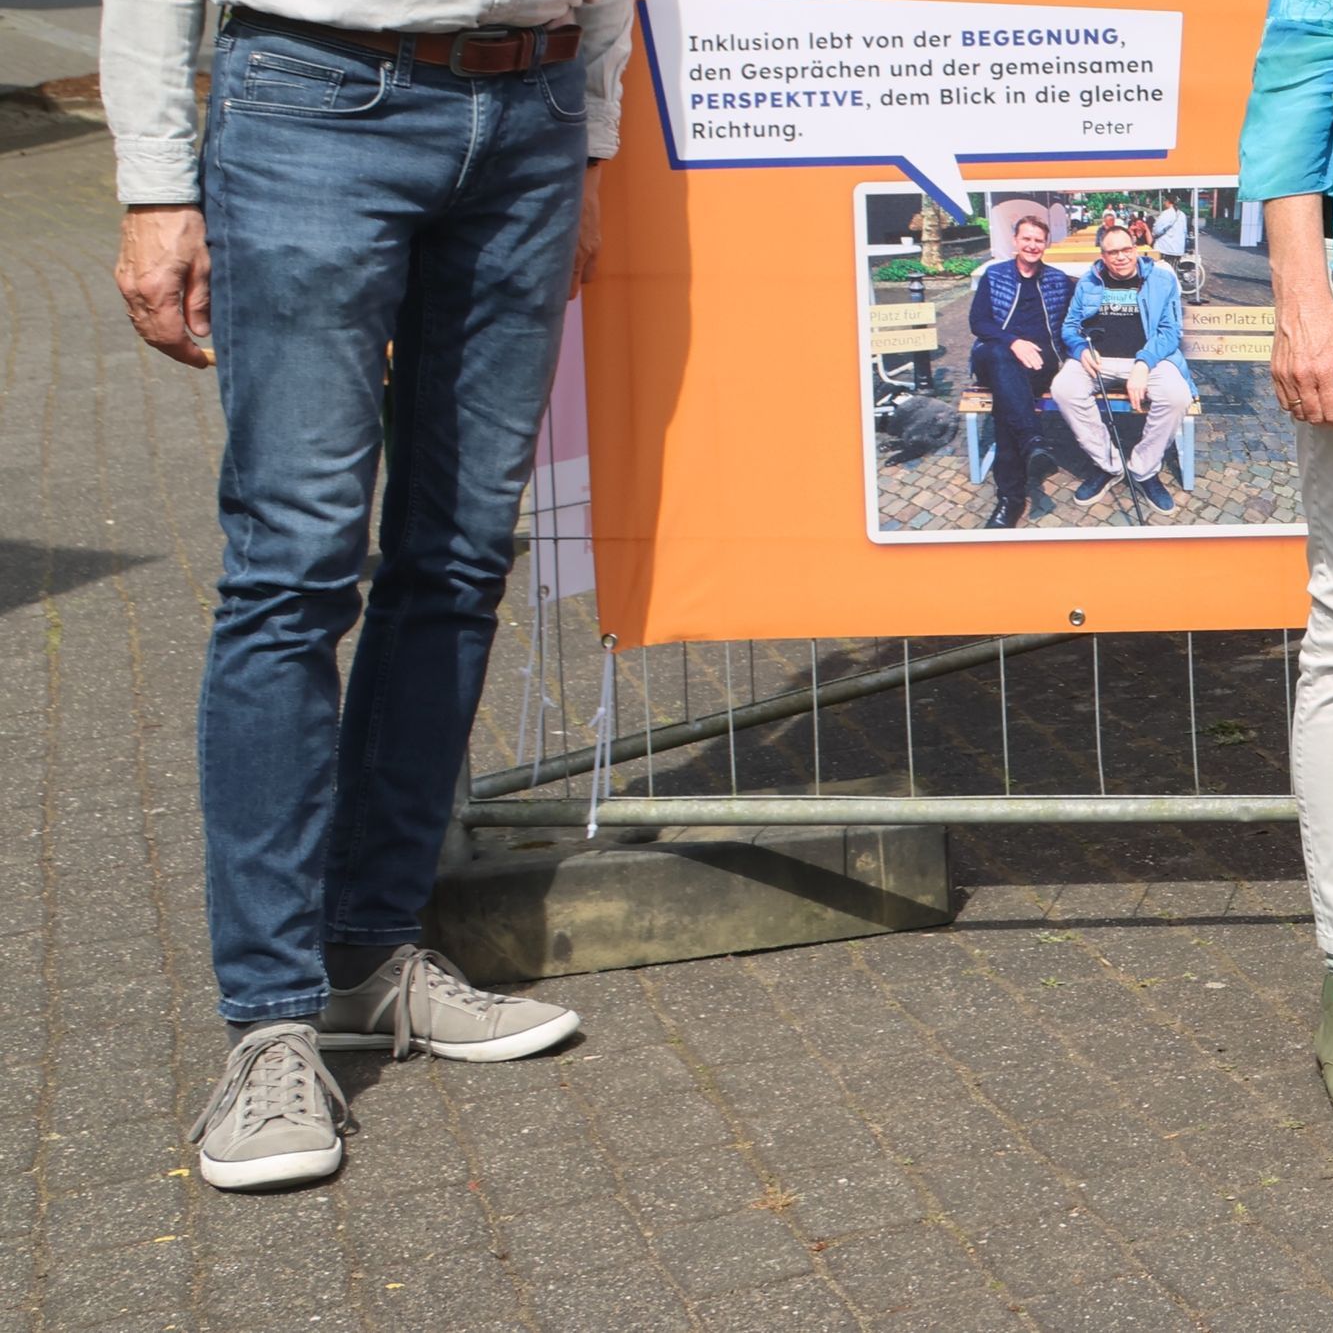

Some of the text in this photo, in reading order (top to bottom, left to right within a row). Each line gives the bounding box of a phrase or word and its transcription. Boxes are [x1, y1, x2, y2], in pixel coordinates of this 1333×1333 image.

[689, 28, 1125, 52] Inklusion lebt von der BEGEGNUNG,
[689, 56, 1153, 84] den Gesprächen und der gemeinsamen
[691, 84, 1163, 110] PERSPEKTIVE, dem Blick in die gleiche
[692, 120, 802, 142] Richtung.
[1083, 120, 1133, 135] Peter
